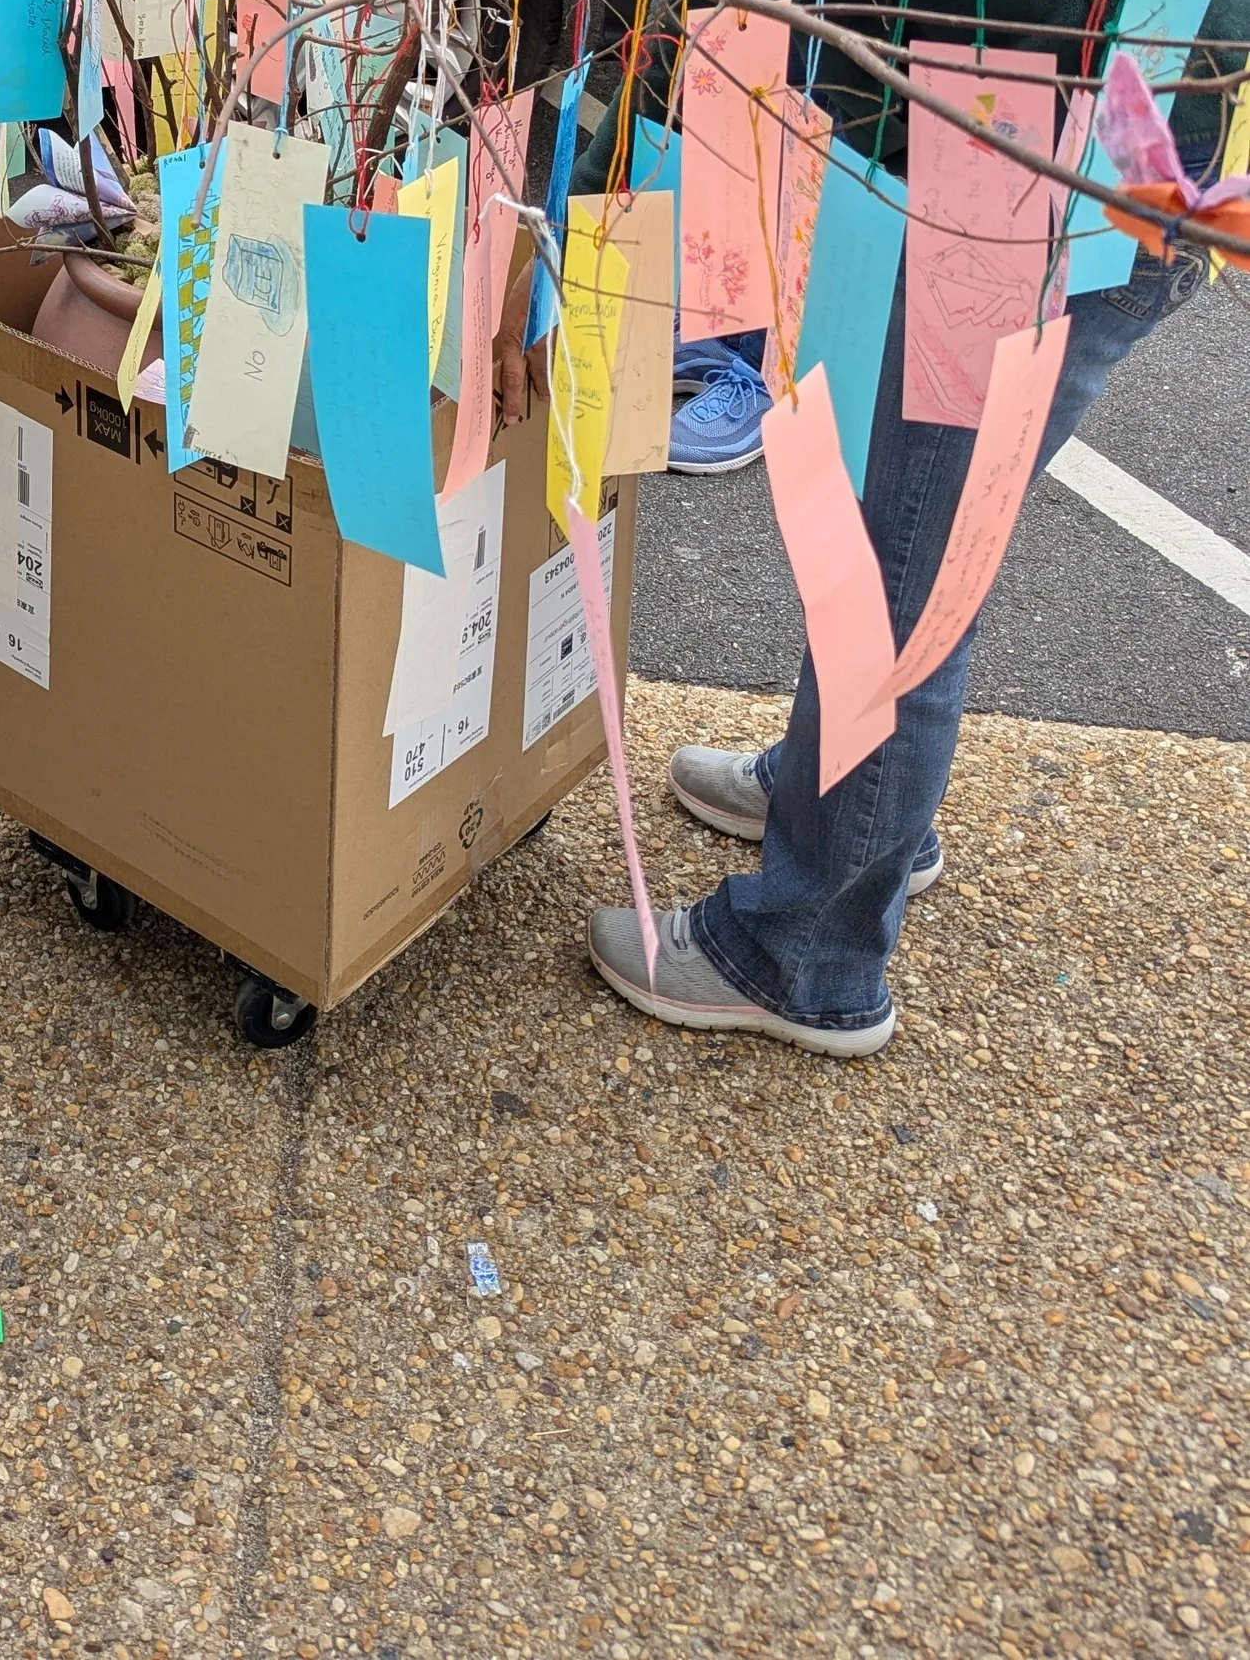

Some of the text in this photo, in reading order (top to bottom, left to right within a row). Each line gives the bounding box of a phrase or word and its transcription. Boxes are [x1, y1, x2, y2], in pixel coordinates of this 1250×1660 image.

[94, 420, 122, 444] MAX
[8, 633, 23, 652] 16
[457, 716, 470, 736] 16
[405, 741, 426, 765] 470
[404, 756, 424, 782] 510
